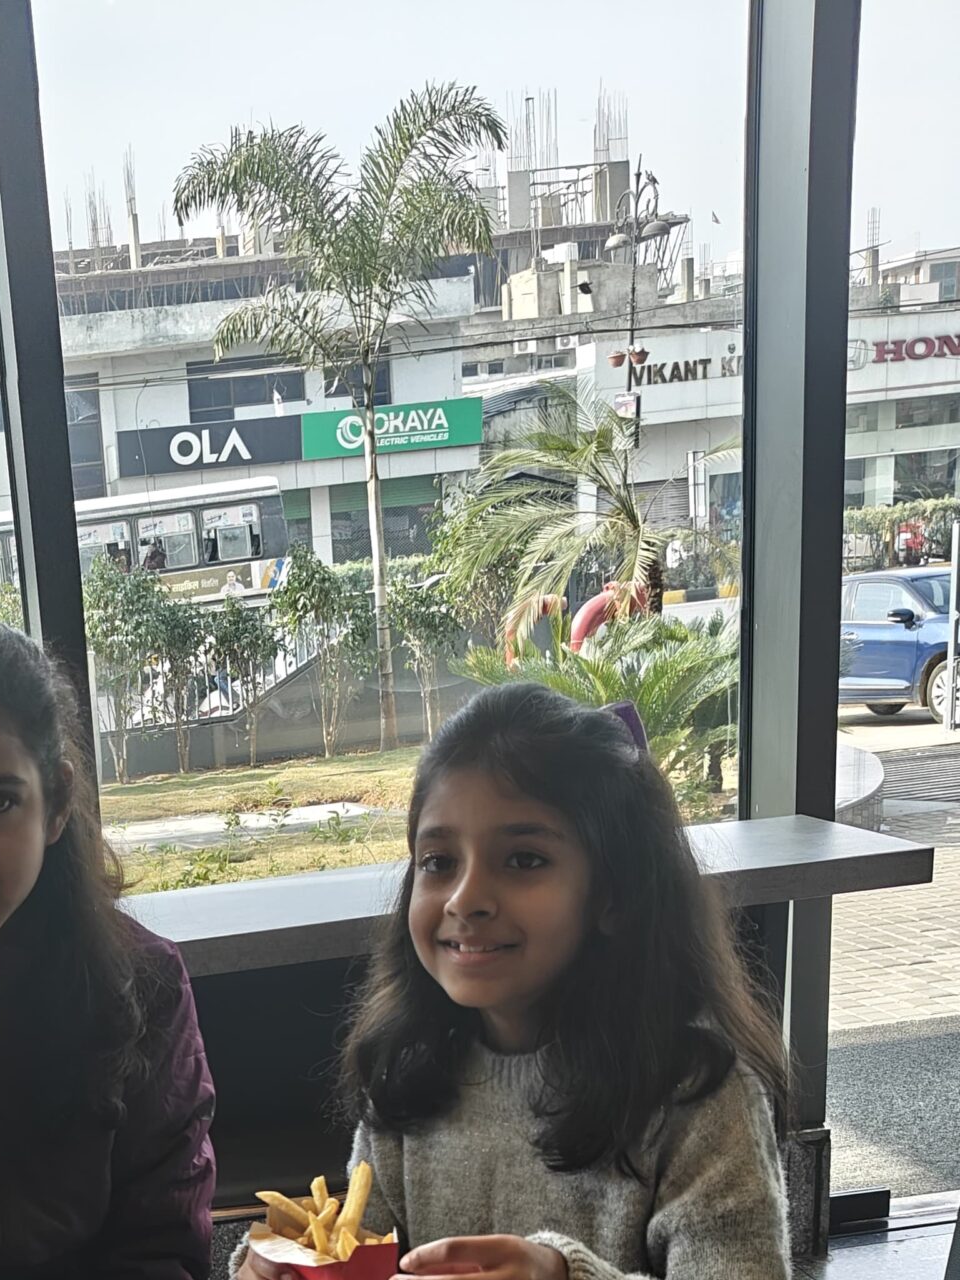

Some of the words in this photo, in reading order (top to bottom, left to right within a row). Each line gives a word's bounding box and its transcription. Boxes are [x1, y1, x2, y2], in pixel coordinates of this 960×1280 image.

[373, 407, 449, 434] OKAYA
[169, 427, 252, 465] OLA
[374, 436, 409, 446] LECTRIC
[410, 432, 449, 443] VEHICLES
